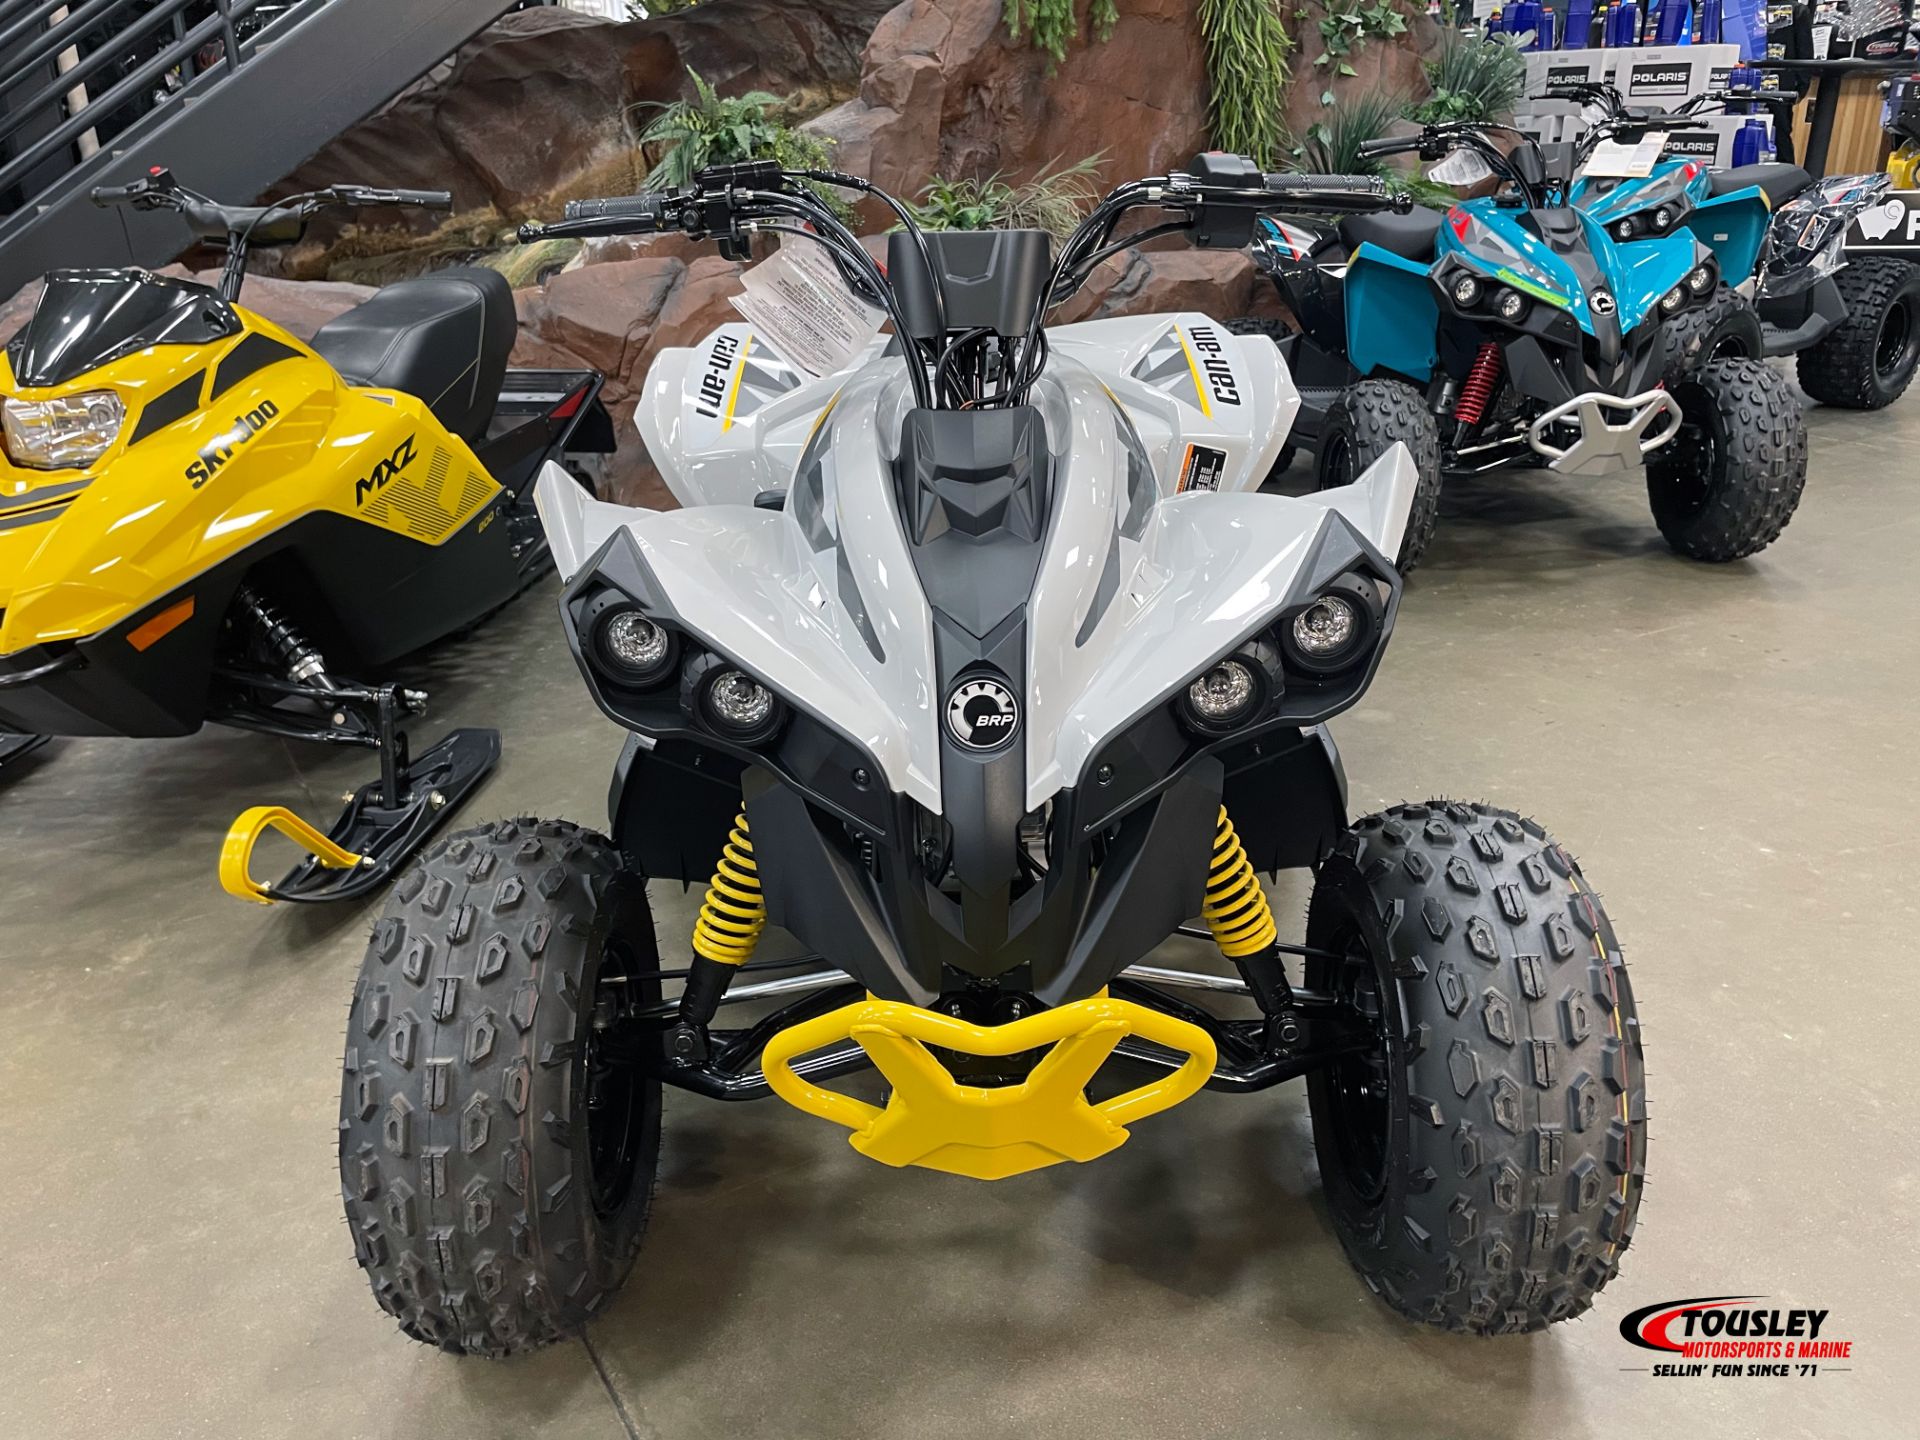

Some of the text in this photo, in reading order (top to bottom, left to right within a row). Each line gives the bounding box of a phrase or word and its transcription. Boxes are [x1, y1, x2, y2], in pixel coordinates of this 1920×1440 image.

[1548, 74, 1587, 85] POLARIS
[1632, 72, 1687, 83] POLARIS
[1664, 141, 1715, 152] POLARIS
[1188, 326, 1241, 406] can-am
[696, 335, 739, 419] can-am
[356, 432, 418, 508] MXZ
[976, 714, 1014, 727] BRP
